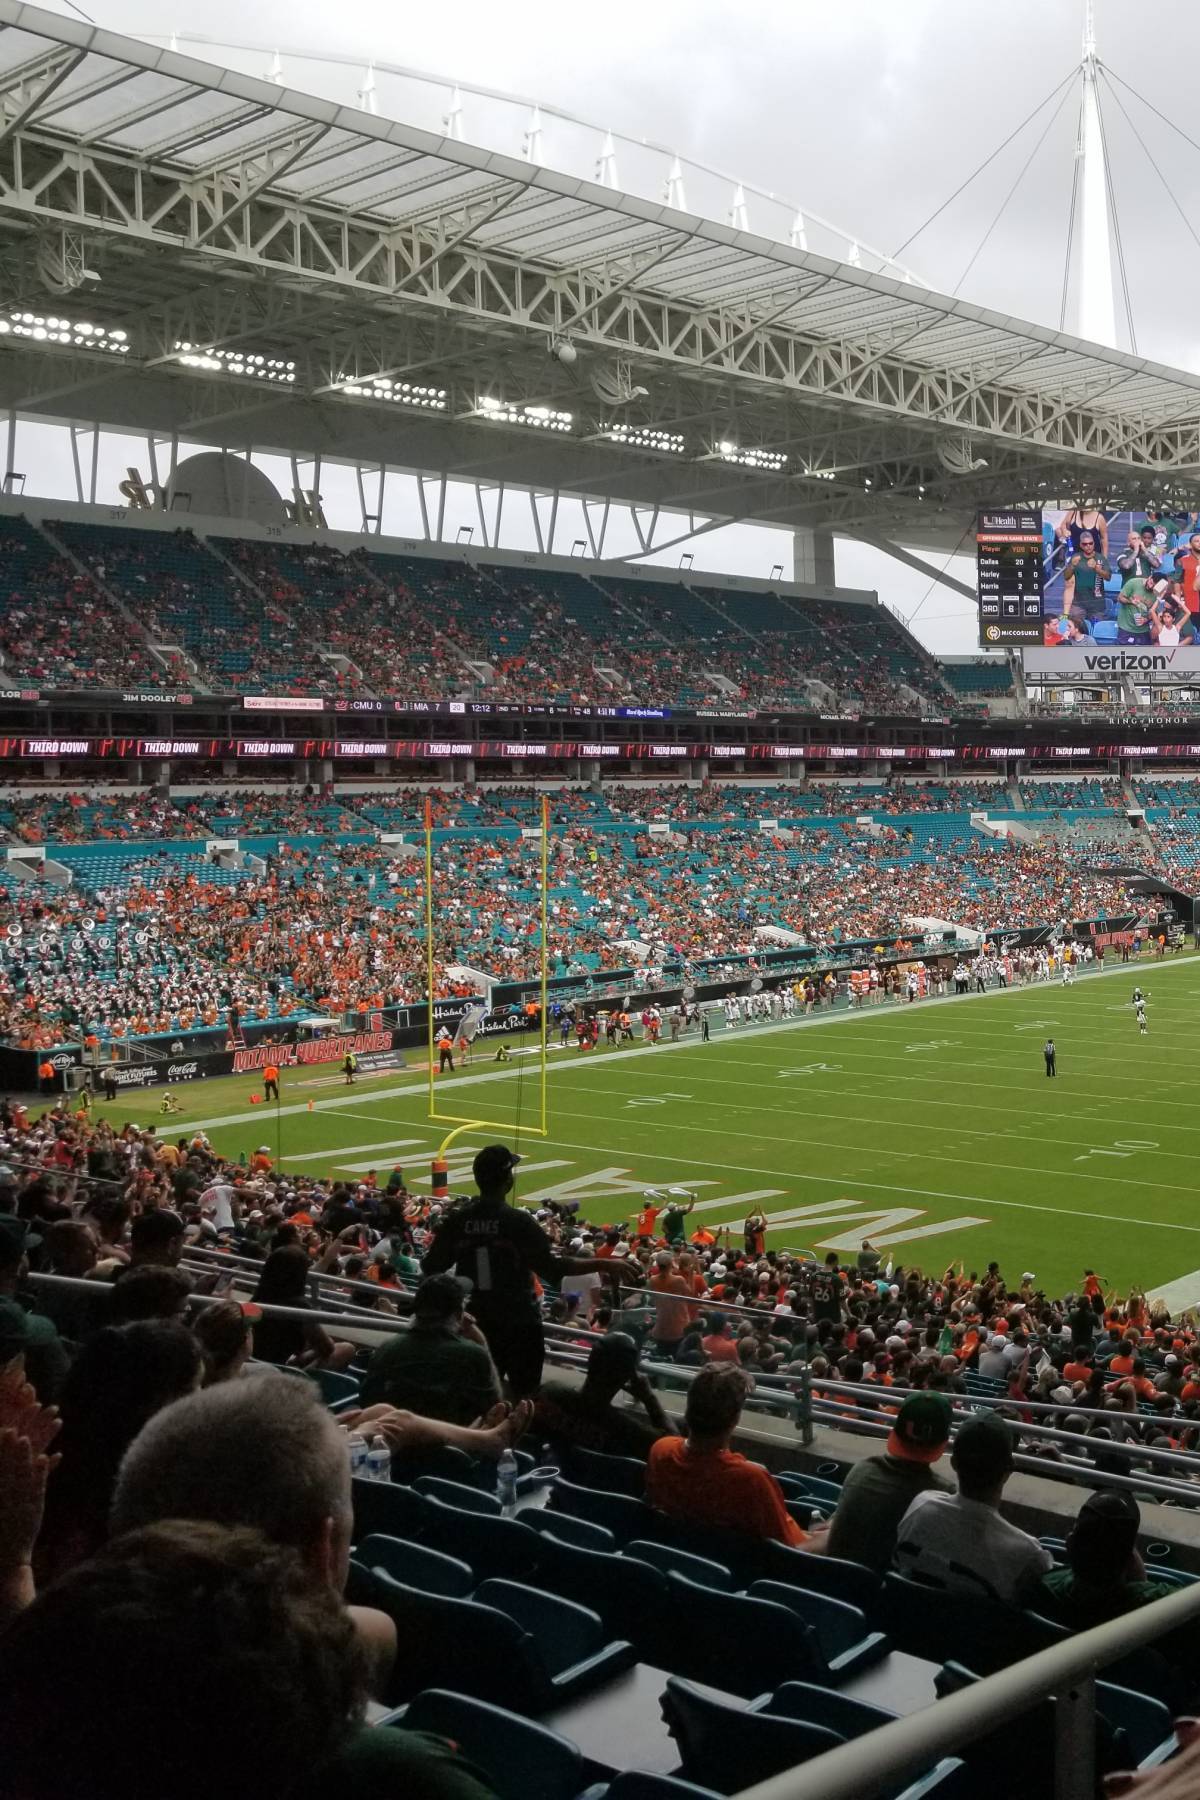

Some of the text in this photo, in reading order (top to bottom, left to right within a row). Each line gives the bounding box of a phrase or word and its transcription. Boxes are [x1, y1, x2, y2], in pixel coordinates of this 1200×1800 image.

[982, 605, 998, 613] 3RD
[1085, 651, 1166, 670] verizon
[141, 695, 177, 703] DOOLEY
[353, 701, 373, 710] CMU
[413, 703, 429, 711] MIA
[471, 704, 491, 713] 12:12
[1109, 717, 1189, 725] RING HONOR
[29, 742, 88, 753] THIRD DOWN
[144, 742, 199, 753] THIRD DOWN
[244, 743, 294, 753] THIRD DOWN
[341, 743, 387, 754] THIRD DOWN
[429, 744, 472, 754] THIRD DOWN
[507, 745, 546, 755] THIRD DOWN
[583, 746, 619, 755] THIRD DOWN
[653, 746, 687, 755] THIRD DOWN
[714, 746, 746, 756] THIRD DOWN
[990, 748, 1025, 756] THIRD DOWN
[234, 1044, 294, 1070] MIAMI
[295, 1031, 393, 1062] HURRICANES
[464, 1220, 500, 1235] CANES
[476, 1246, 492, 1291] 1
[814, 1286, 830, 1302] 26
